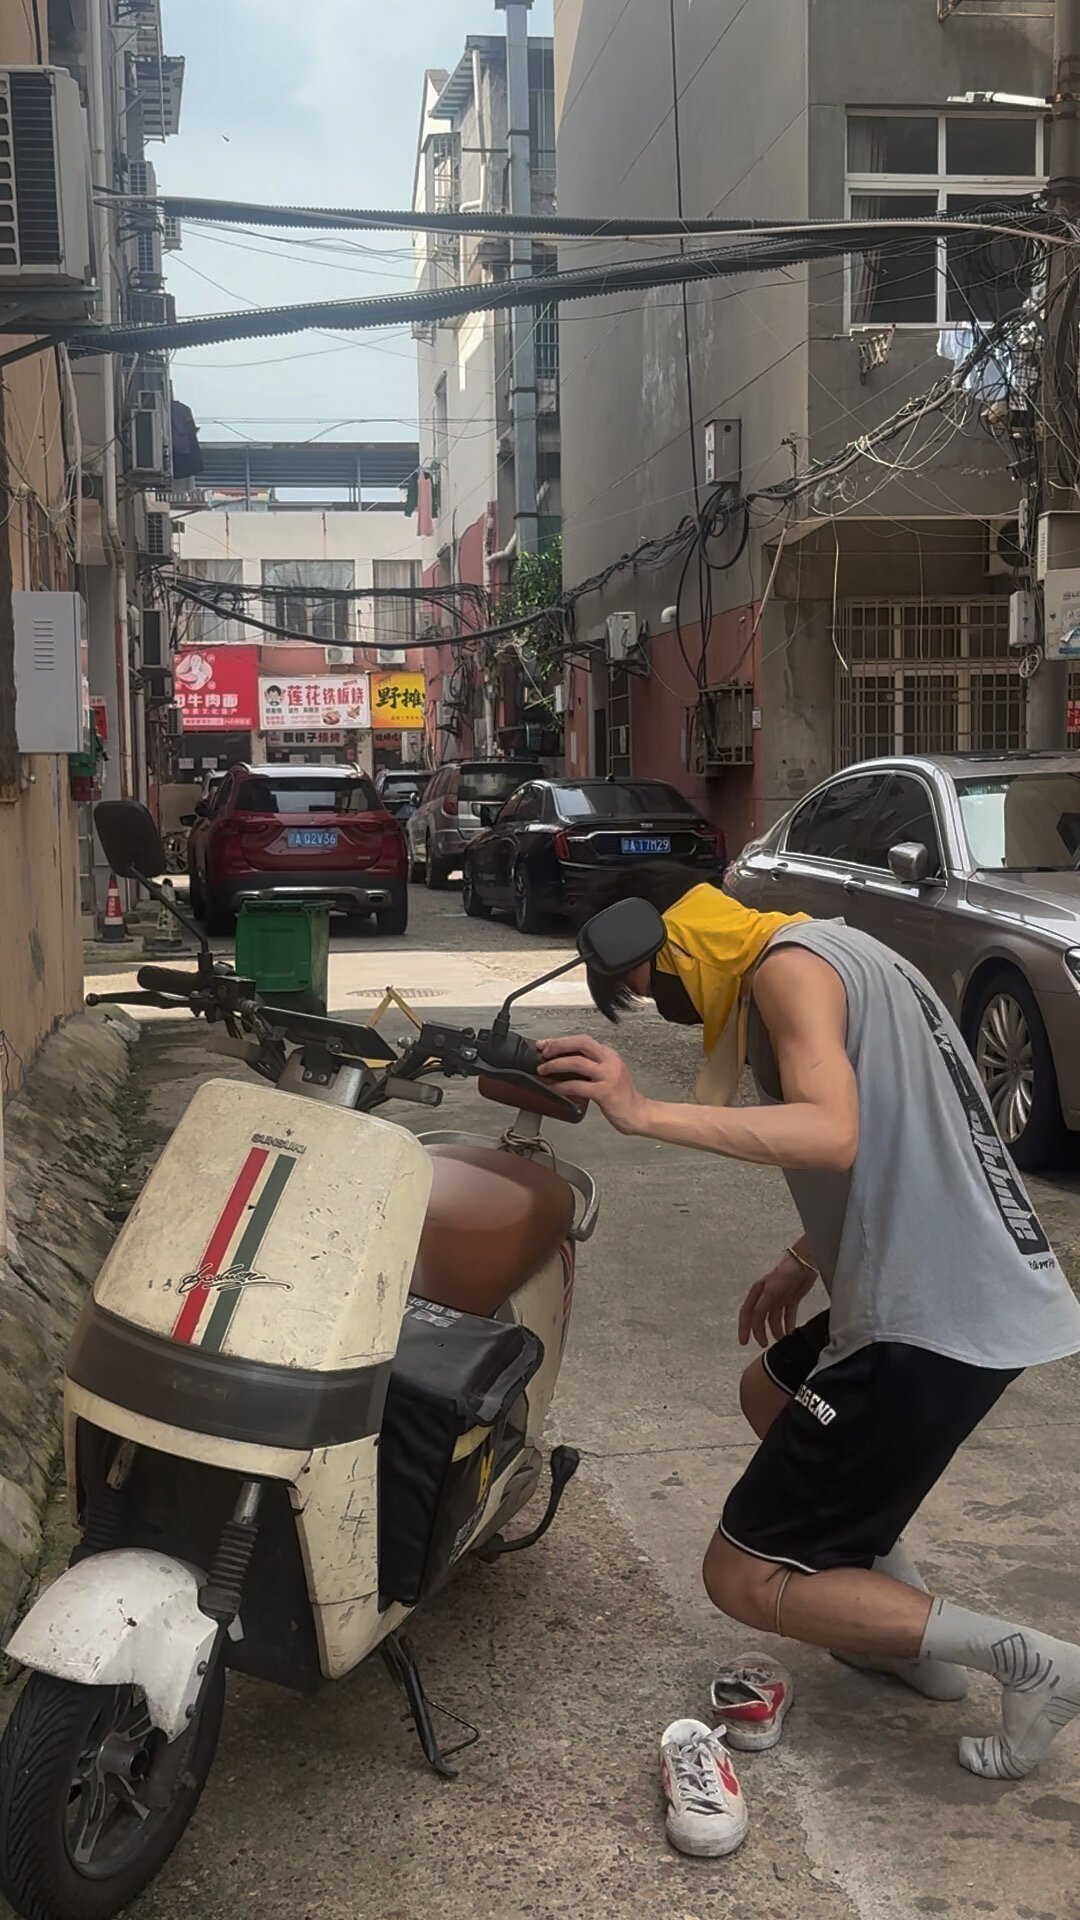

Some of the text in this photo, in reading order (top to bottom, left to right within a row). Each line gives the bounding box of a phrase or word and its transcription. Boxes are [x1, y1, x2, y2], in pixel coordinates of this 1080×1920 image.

[286, 685, 364, 706] 莲花铁板烧
[376, 687, 426, 709] 野摊
[794, 1384, 837, 1426] EGEND
